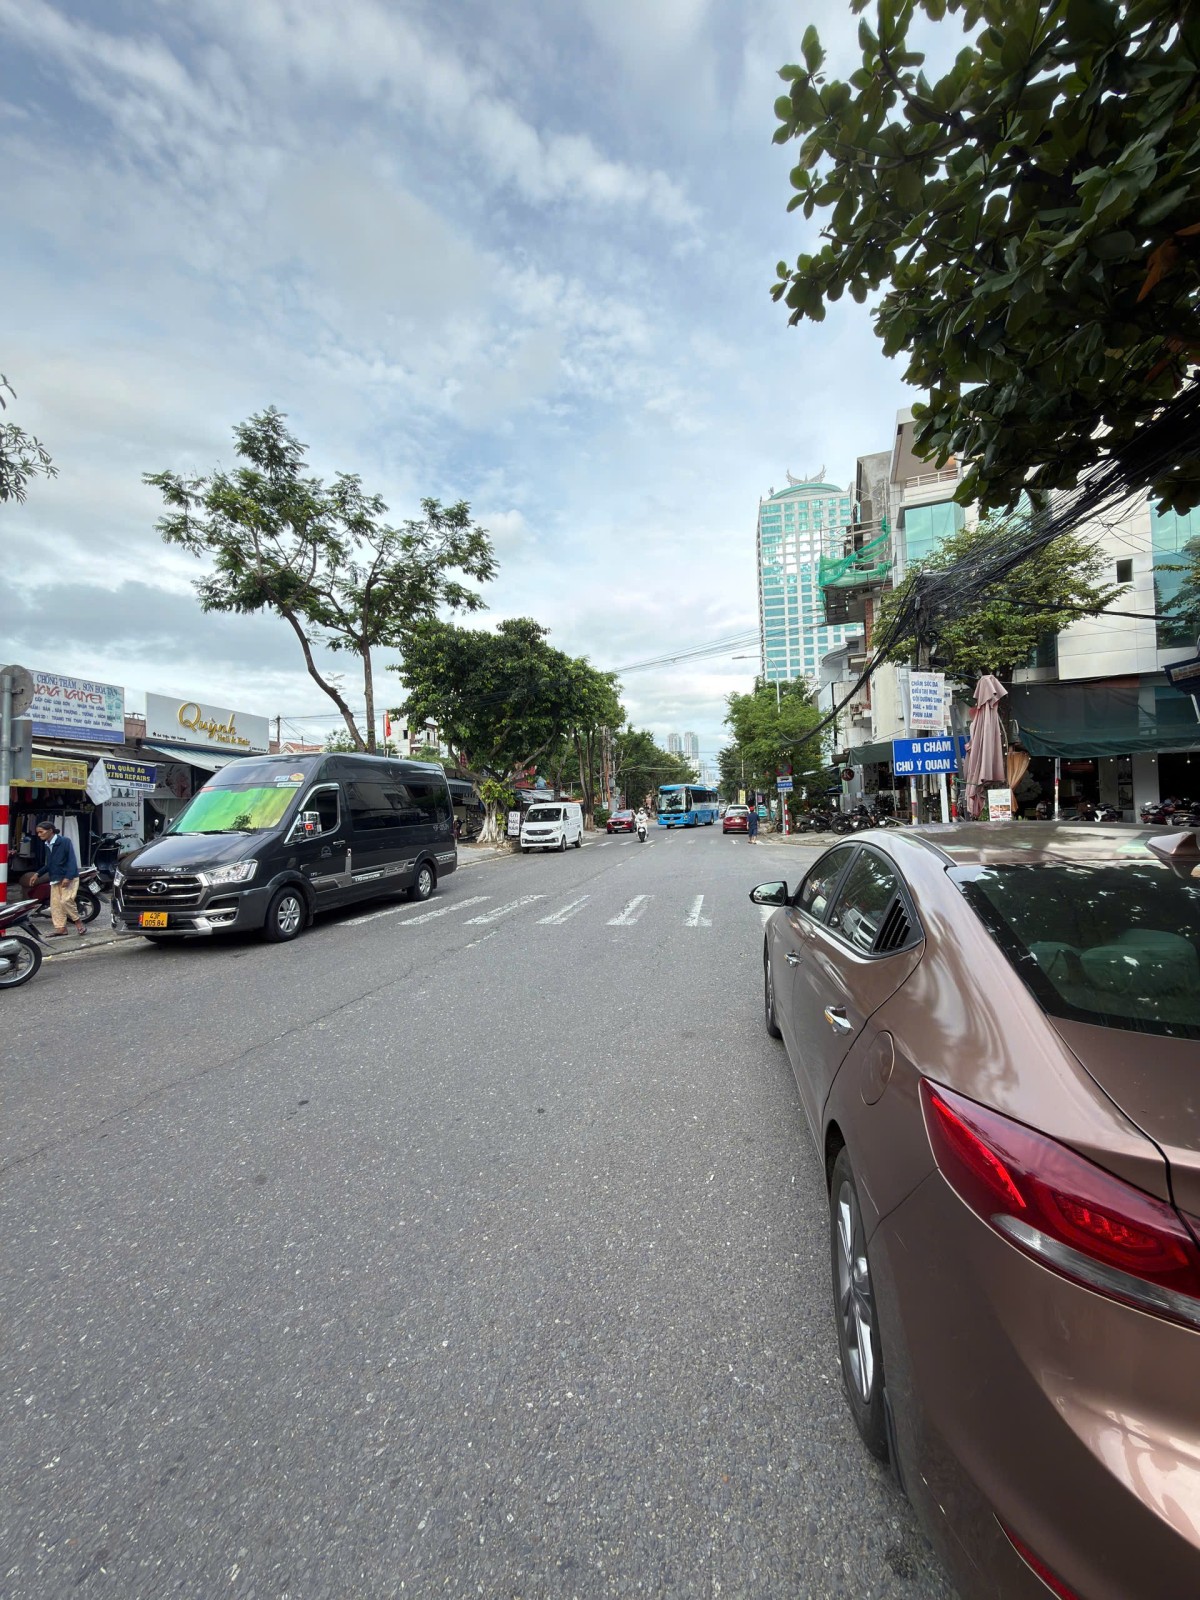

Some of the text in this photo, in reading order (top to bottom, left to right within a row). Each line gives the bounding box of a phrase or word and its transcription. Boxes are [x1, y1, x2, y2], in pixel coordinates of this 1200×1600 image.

[177, 702, 237, 739] Quỳnh
[912, 743, 921, 754] ĐI
[104, 762, 116, 770] ỬA
[896, 758, 914, 772] CHÚ
[916, 759, 922, 771] Ý
[925, 759, 950, 771] QUAN
[124, 774, 150, 782] REPAIRS
